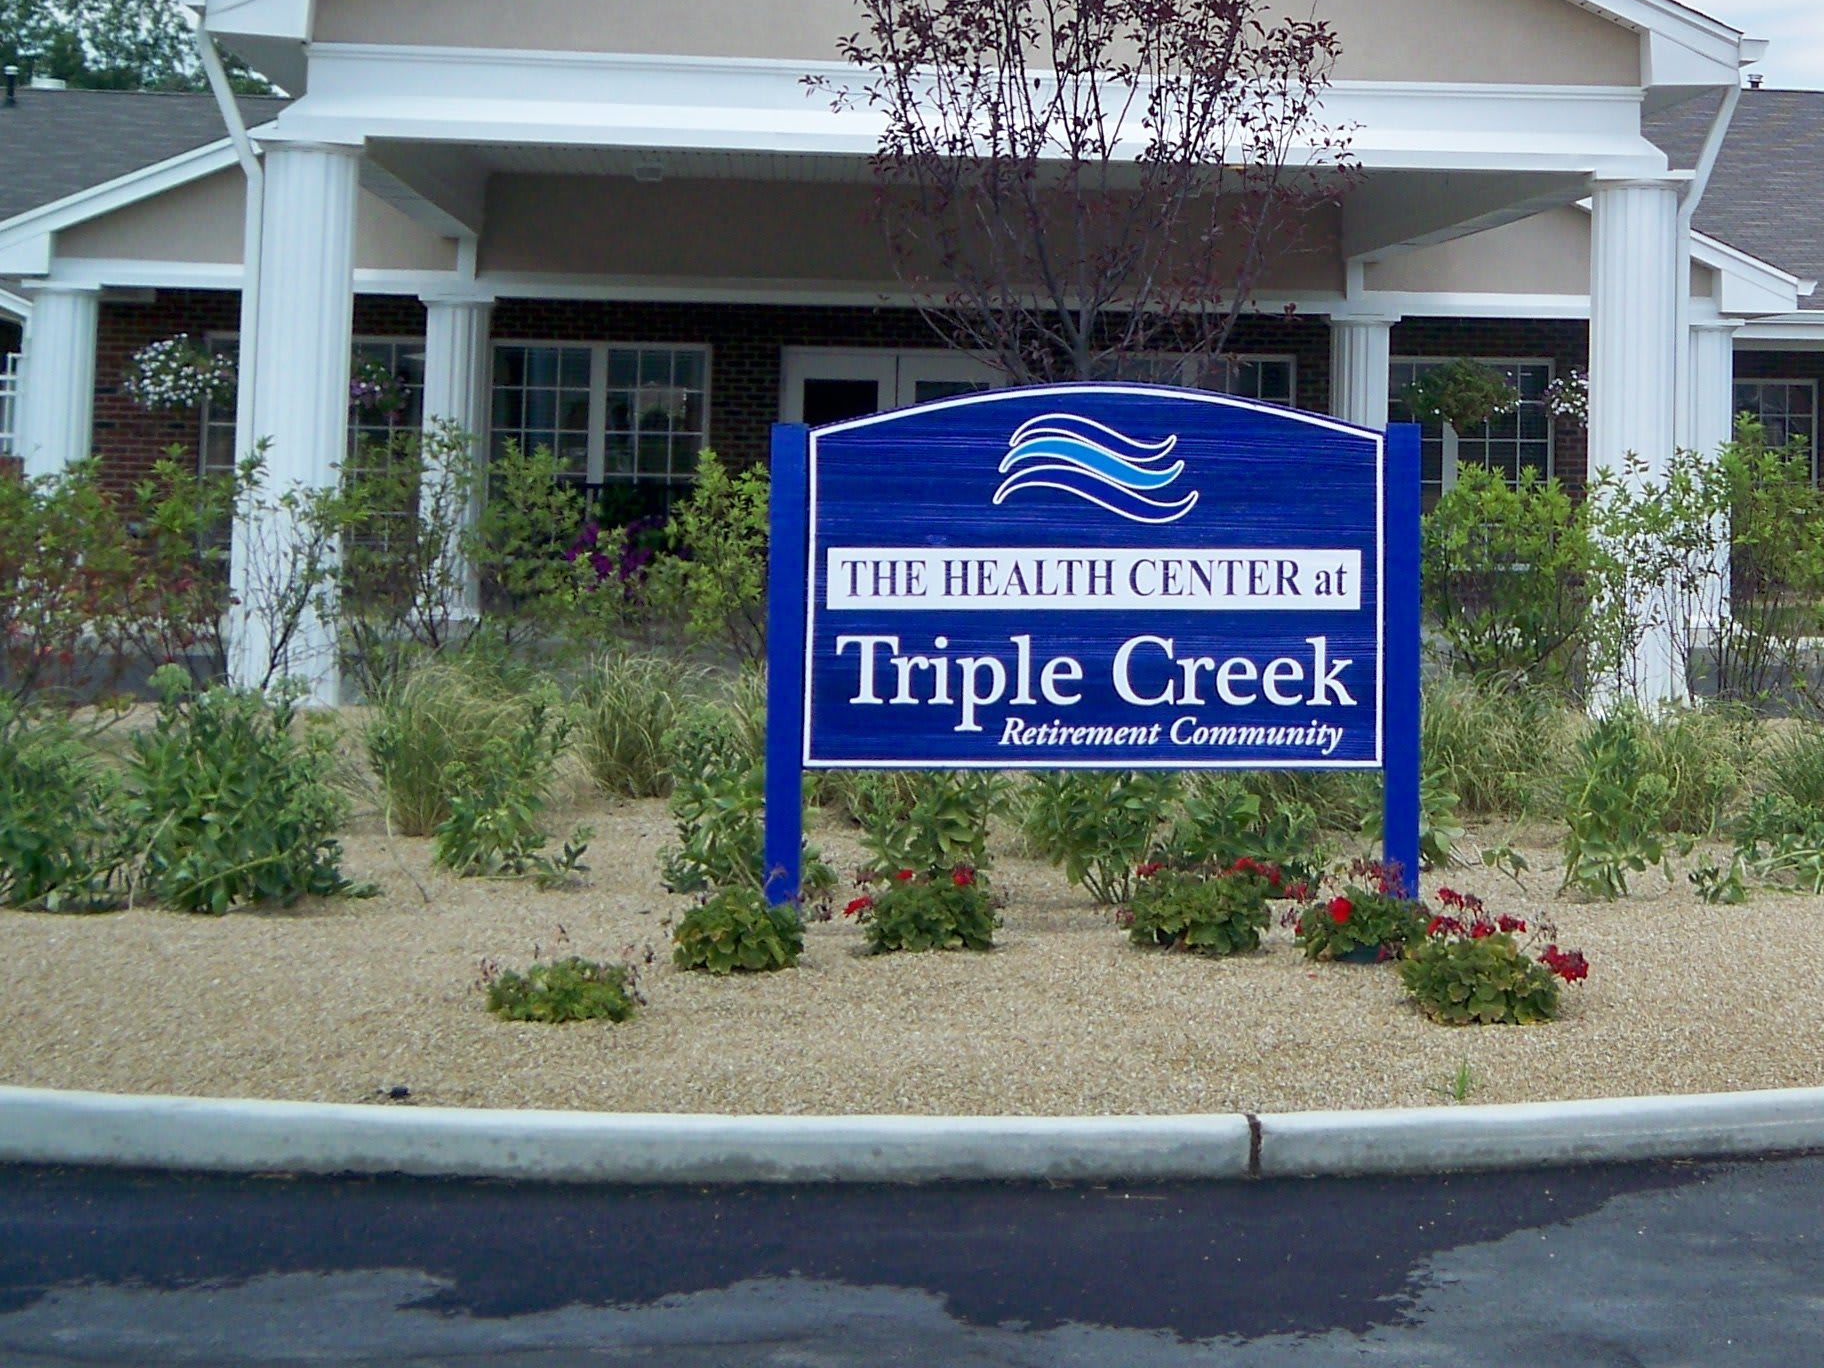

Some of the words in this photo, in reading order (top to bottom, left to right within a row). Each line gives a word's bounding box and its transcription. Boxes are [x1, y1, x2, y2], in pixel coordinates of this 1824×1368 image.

[841, 559, 927, 598] THE
[942, 558, 1116, 597] HEALTH
[1128, 558, 1301, 596] CENTER
[1314, 563, 1347, 597] at
[836, 635, 1083, 731] Triple
[1112, 635, 1357, 706] Creek
[998, 717, 1162, 747] Retirement
[1169, 717, 1343, 756] Community
